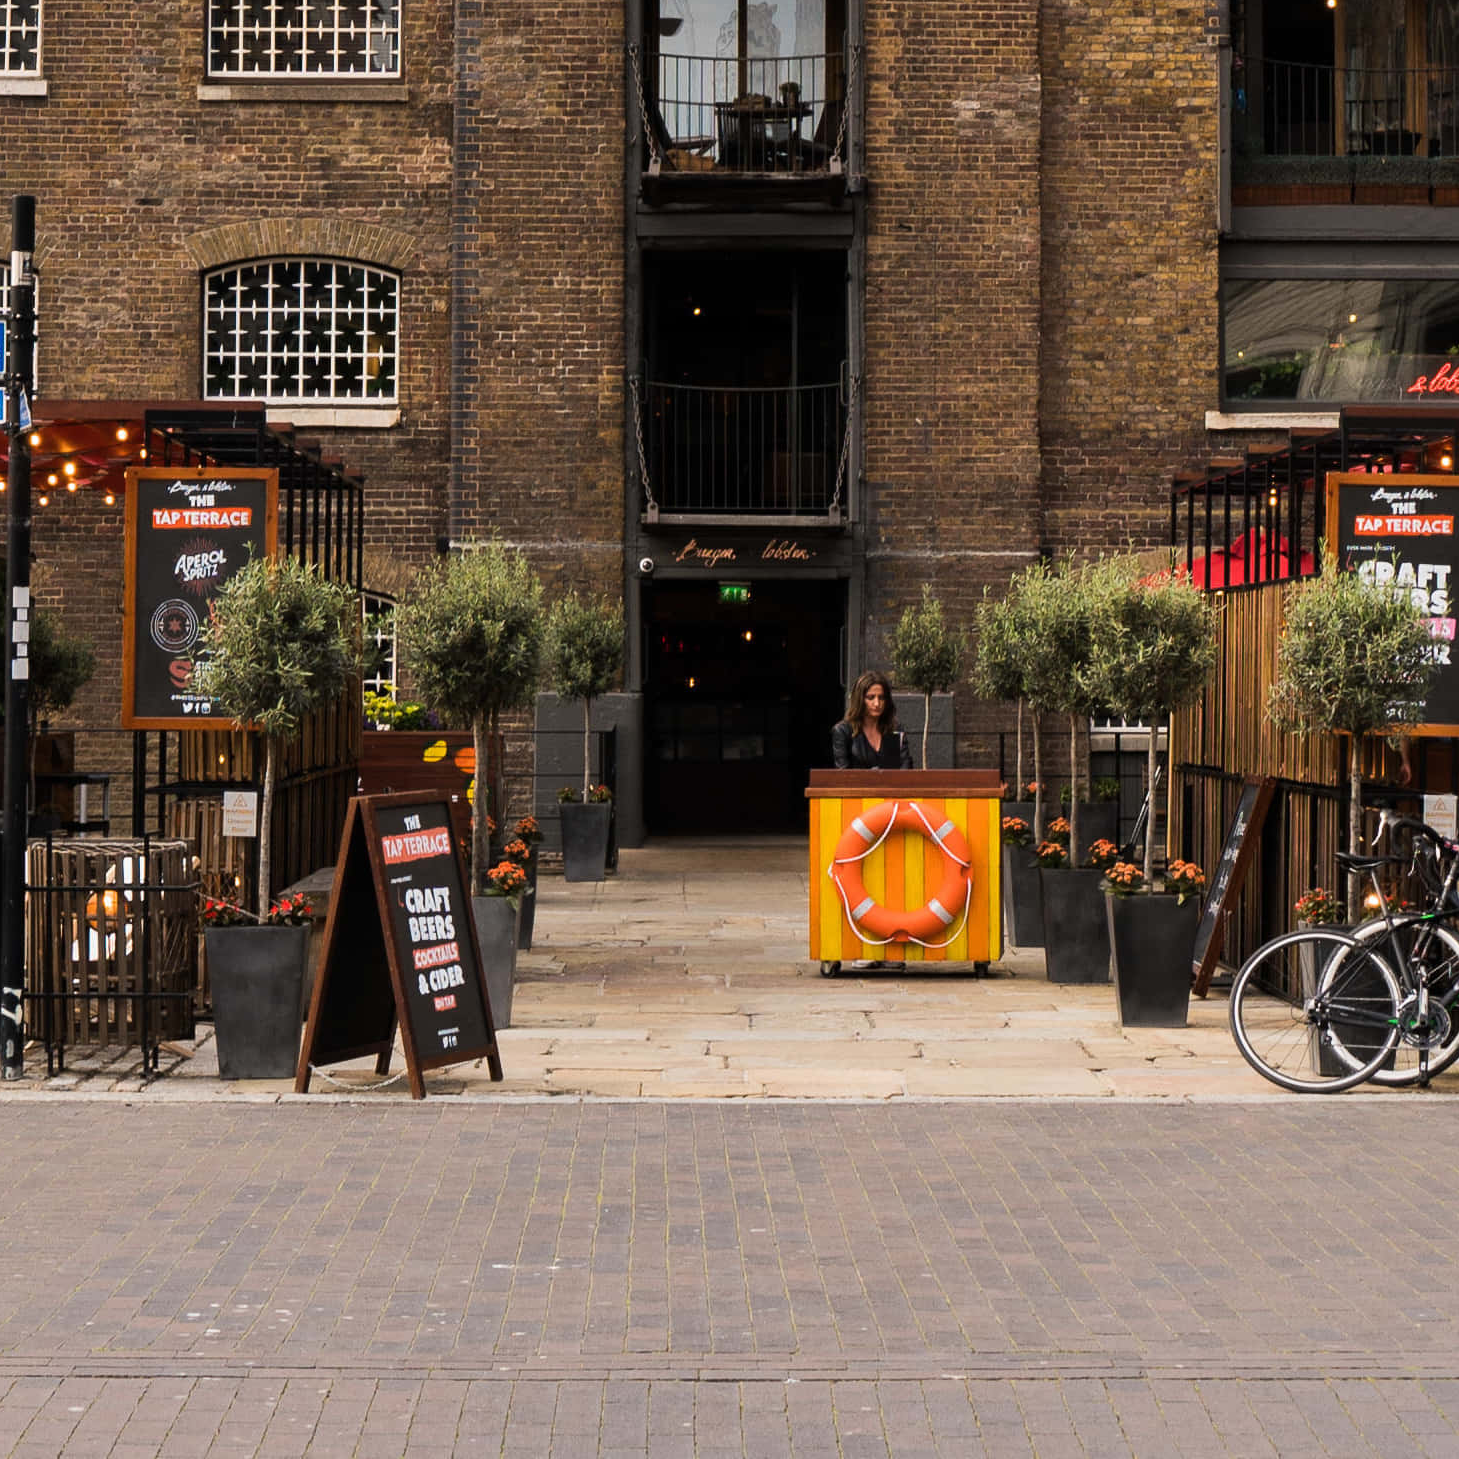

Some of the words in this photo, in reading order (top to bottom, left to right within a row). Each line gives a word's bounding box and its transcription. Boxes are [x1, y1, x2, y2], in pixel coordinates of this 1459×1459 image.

[188, 494, 215, 508] THE
[1391, 502, 1417, 515] THE
[153, 510, 180, 525] TAP
[182, 511, 249, 526] TERRACE
[1355, 517, 1383, 532] TAP
[1385, 518, 1451, 534] TERRACE
[174, 549, 227, 575] APEROL
[1358, 560, 1451, 588] CRAFT
[403, 814, 421, 831] THE
[383, 839, 403, 858] TAP
[404, 833, 450, 855] TERRACE
[405, 886, 451, 914] CRAFT
[408, 914, 456, 943] BEERS
[414, 941, 458, 969] COCKTAILS
[418, 973, 430, 995] &
[429, 964, 465, 992] CIDER
